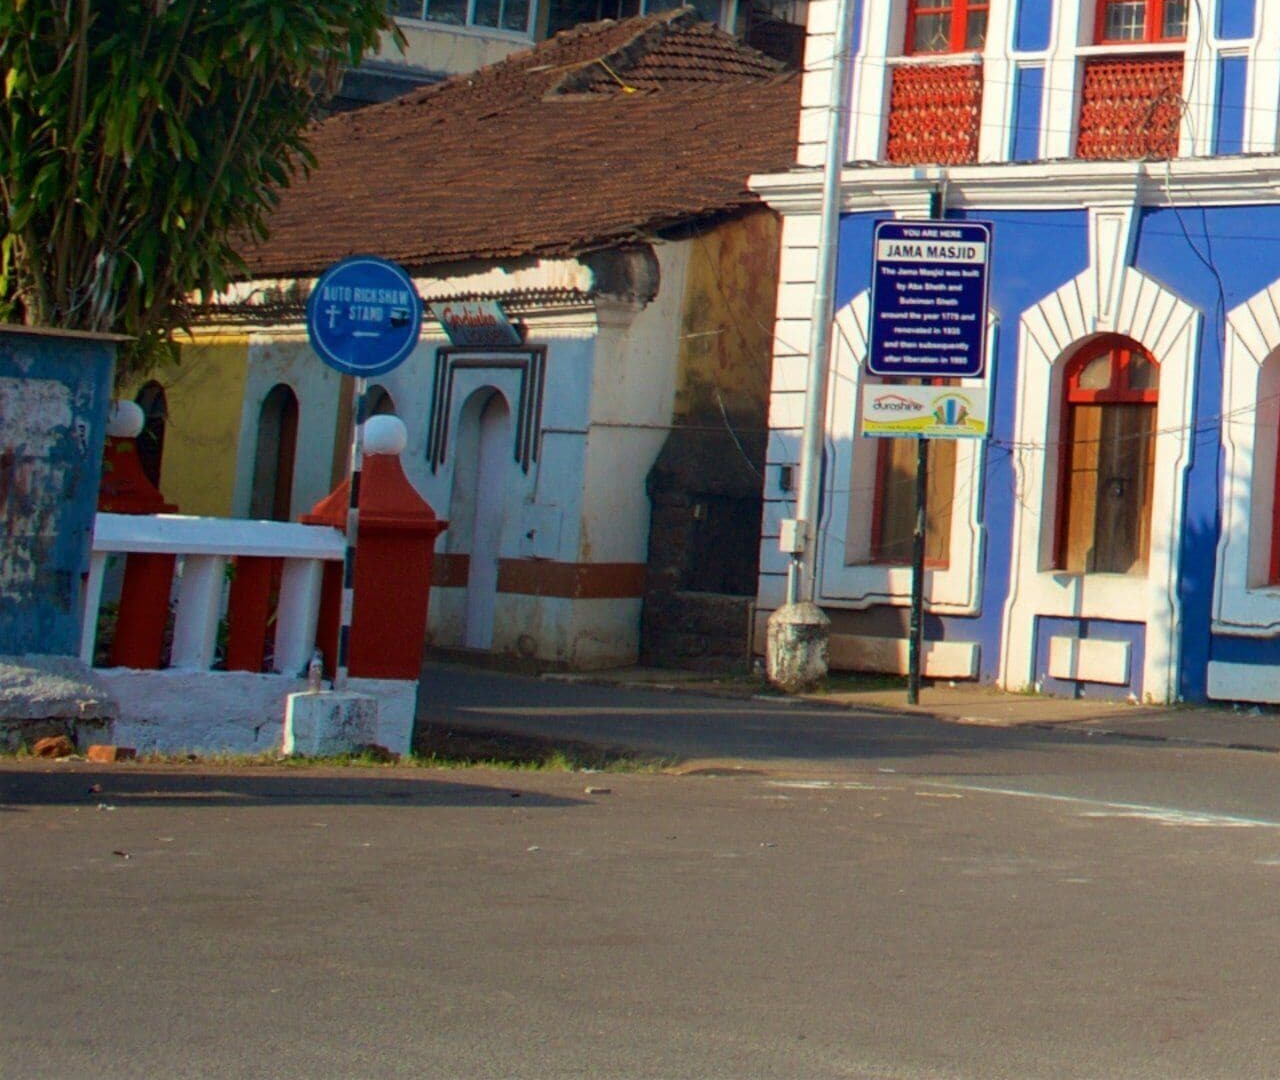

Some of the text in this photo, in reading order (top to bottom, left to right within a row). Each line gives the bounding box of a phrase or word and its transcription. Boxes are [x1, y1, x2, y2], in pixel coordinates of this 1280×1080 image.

[903, 228, 962, 238] YOU ARE HERE
[887, 245, 976, 259] JAMA MASJID
[323, 286, 352, 301] AUTO
[348, 305, 384, 322] STAND
